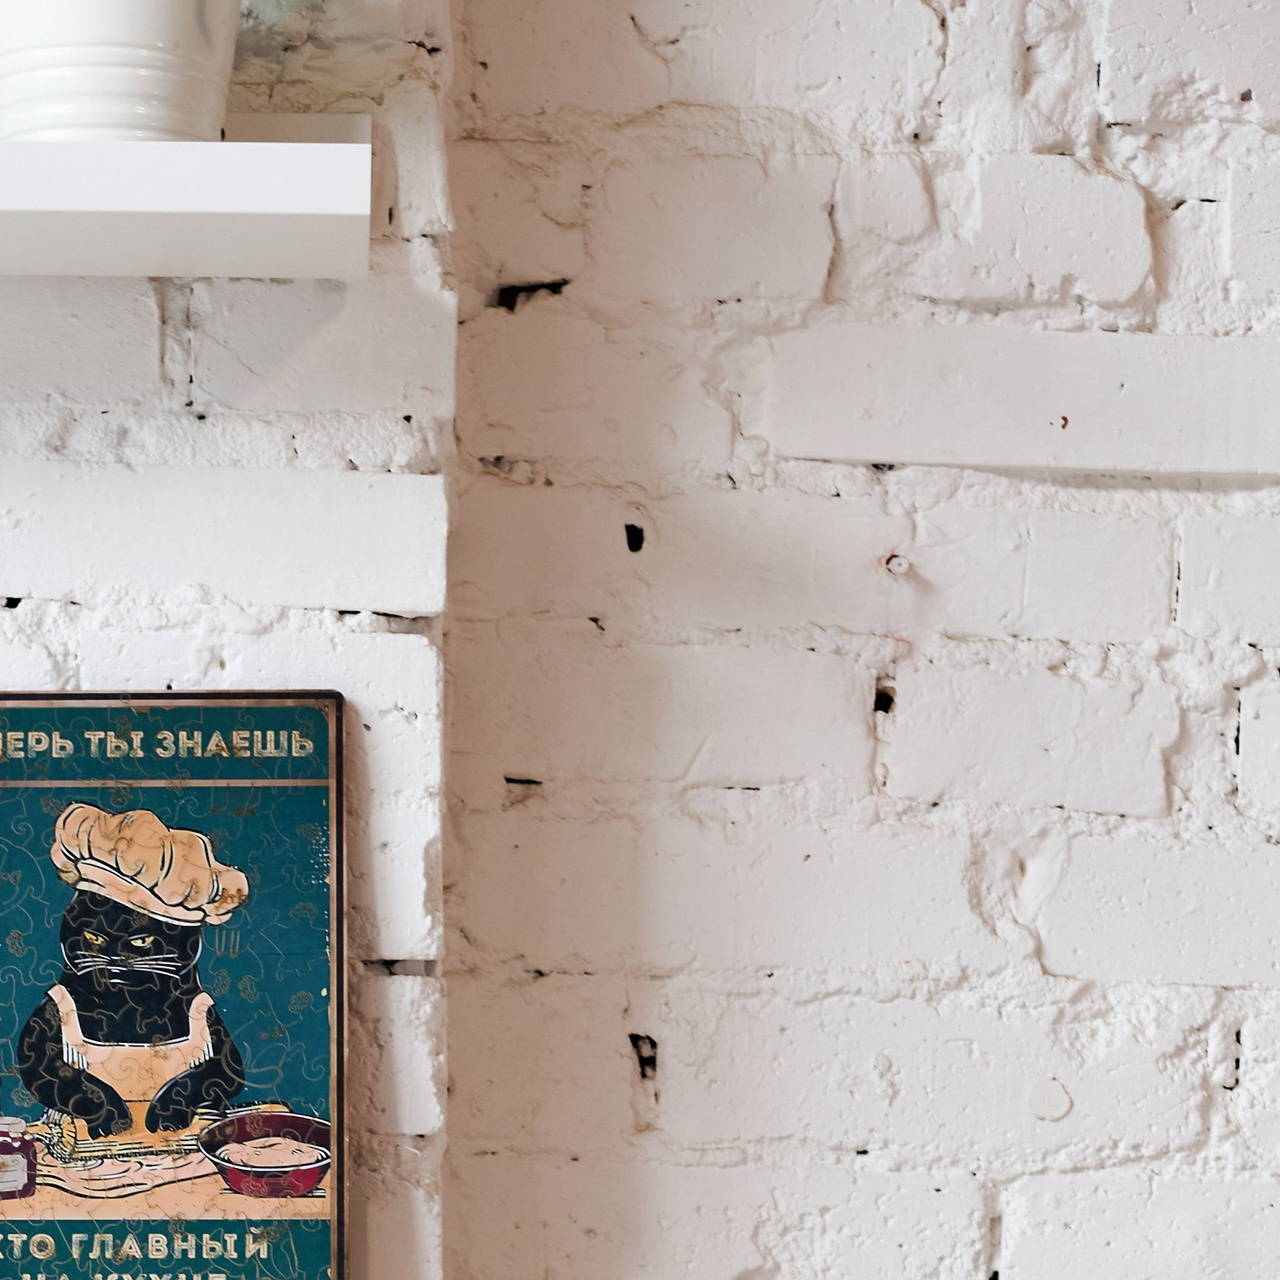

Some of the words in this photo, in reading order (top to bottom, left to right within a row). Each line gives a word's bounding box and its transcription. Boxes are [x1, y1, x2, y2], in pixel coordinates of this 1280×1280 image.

[84, 731, 145, 758] ТЫ
[155, 730, 315, 758] ЗНАЕШЬ
[71, 1227, 269, 1260] ГЛАВНЫЙ
